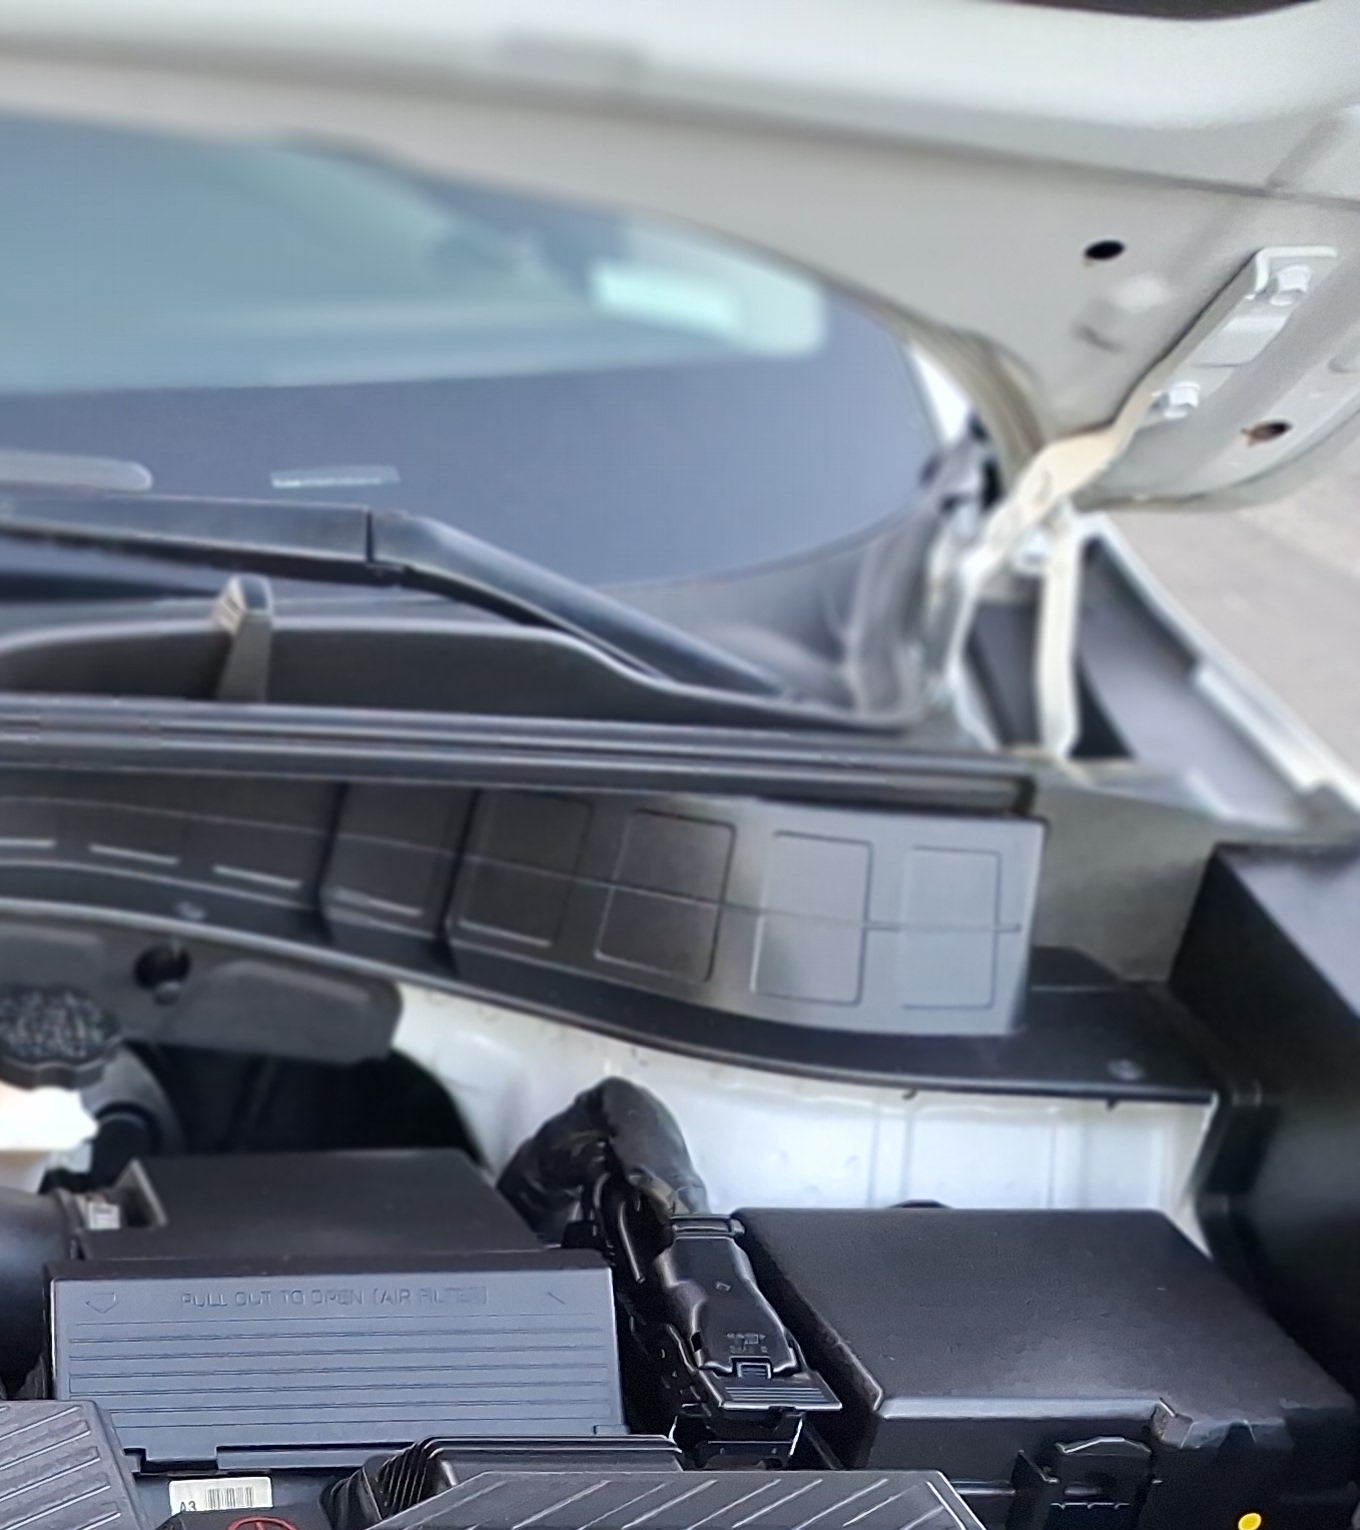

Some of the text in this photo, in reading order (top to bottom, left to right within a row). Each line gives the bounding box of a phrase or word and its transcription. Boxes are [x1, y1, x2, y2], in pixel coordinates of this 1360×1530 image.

[182, 1292, 228, 1308] PULL
[235, 1290, 273, 1307] OUT
[281, 1289, 306, 1306] TO
